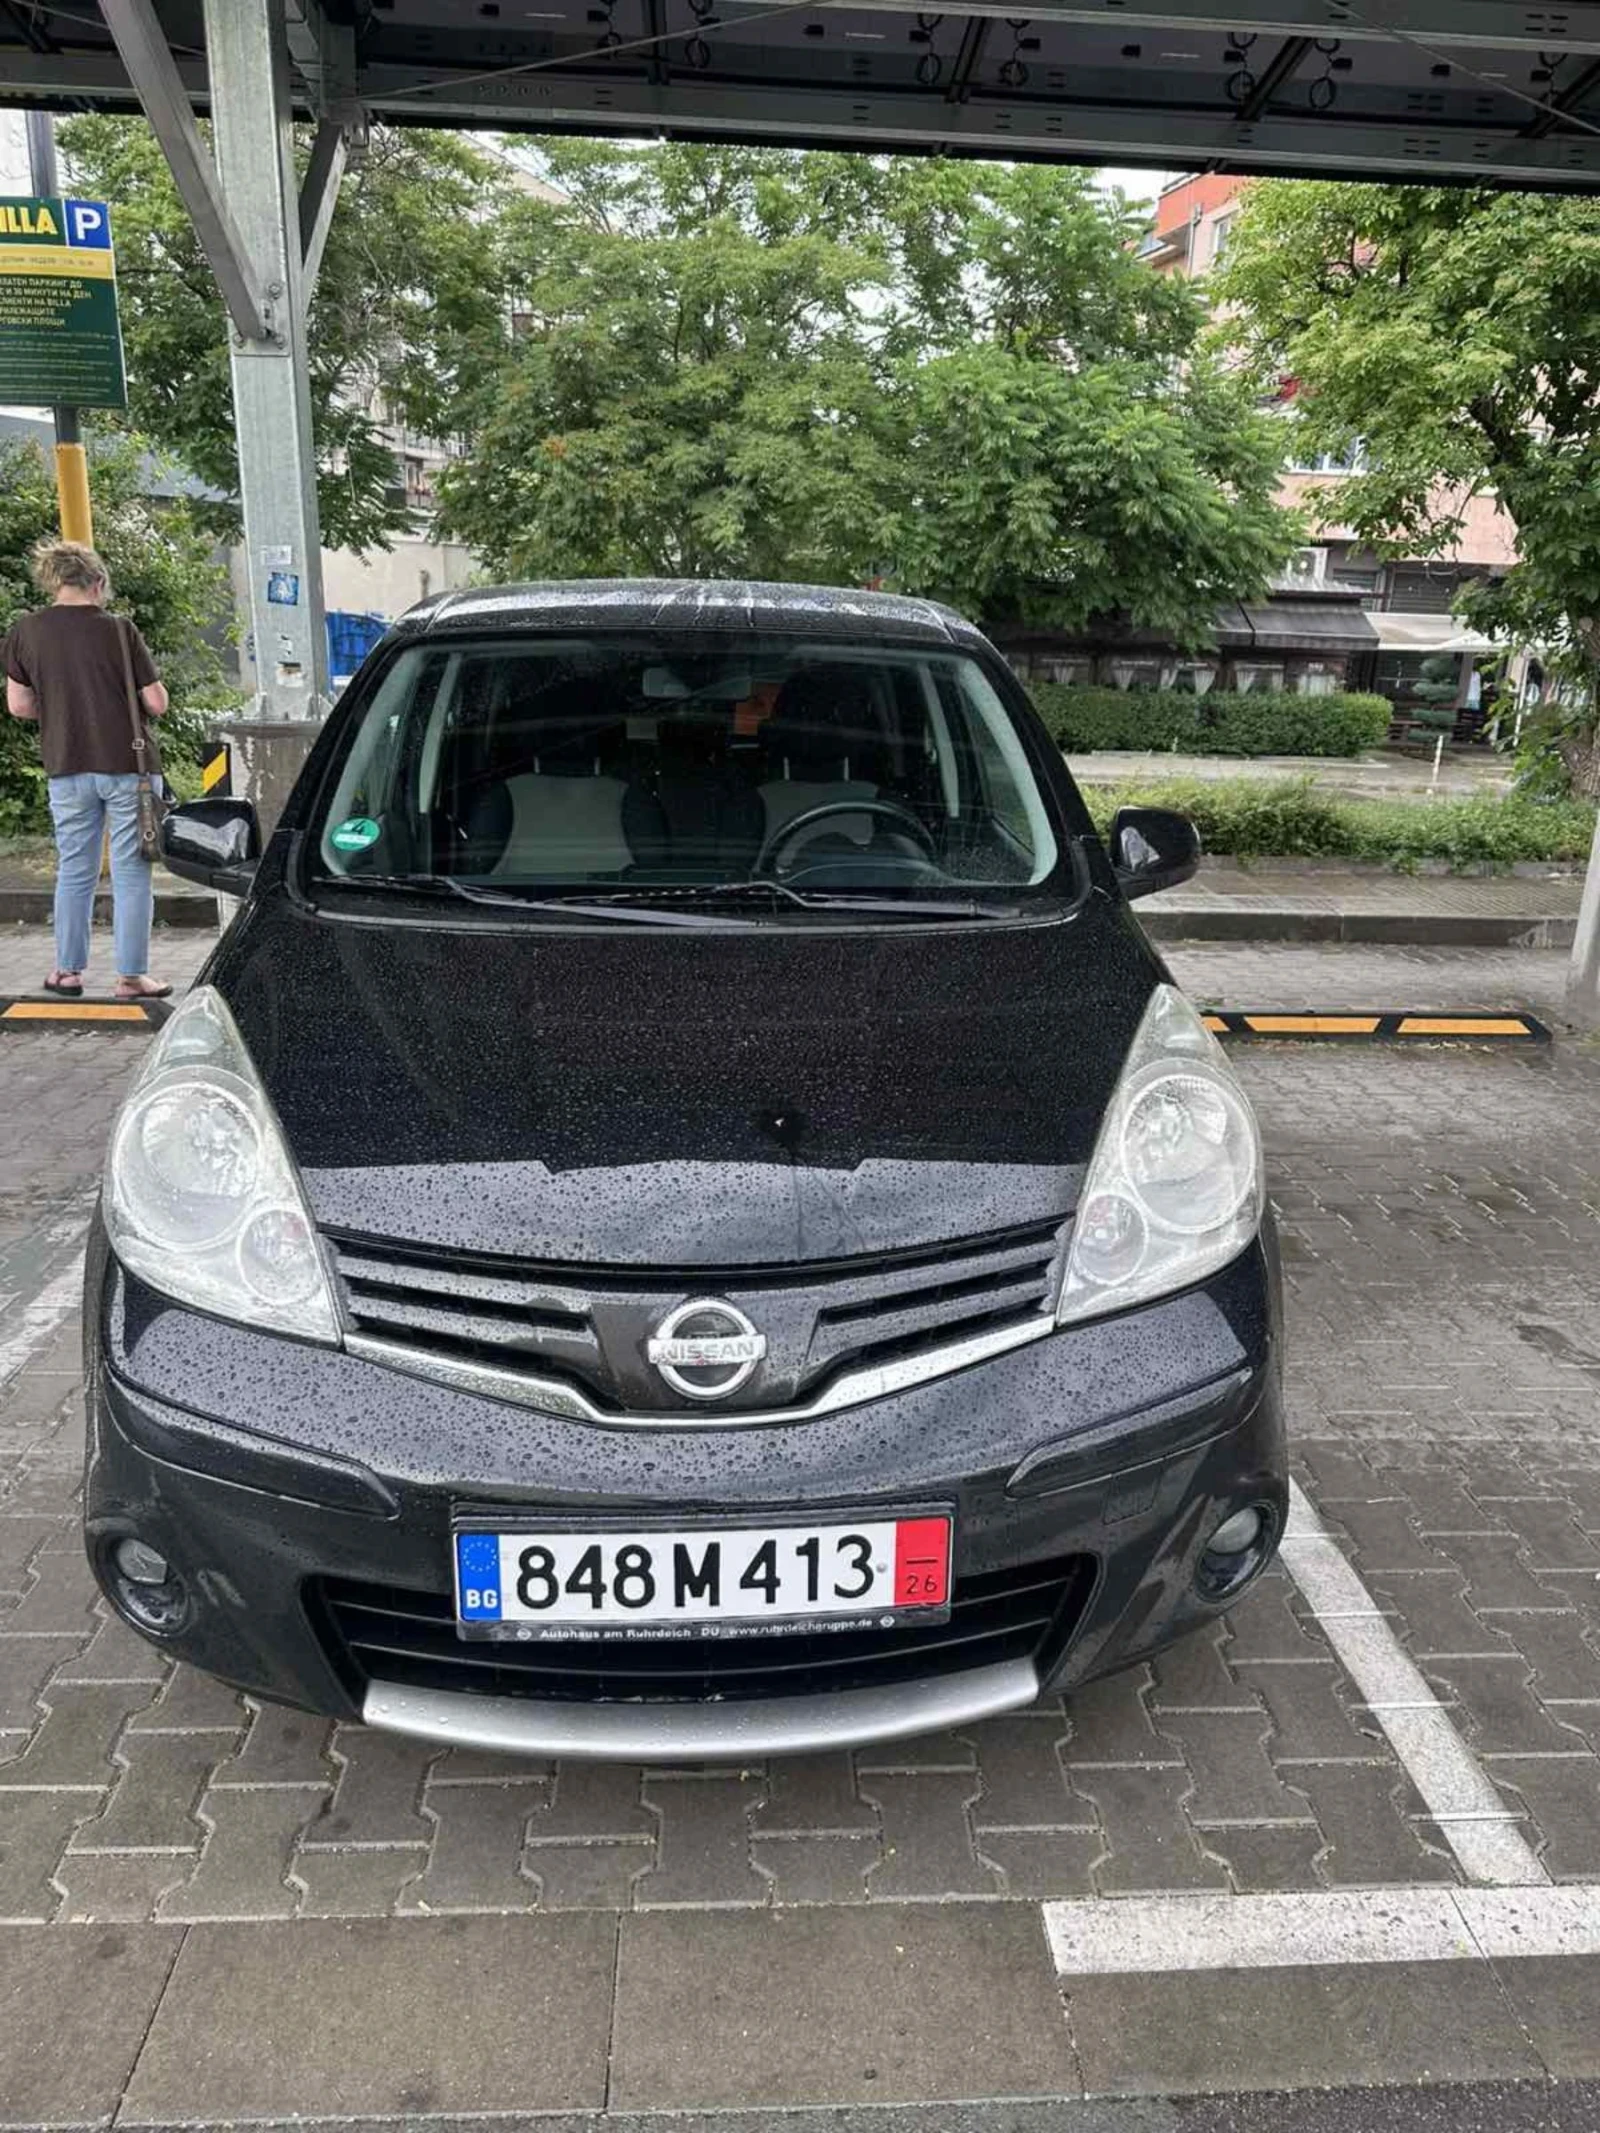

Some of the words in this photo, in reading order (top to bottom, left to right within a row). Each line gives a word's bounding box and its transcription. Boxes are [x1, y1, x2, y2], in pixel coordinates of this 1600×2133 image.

[75, 207, 101, 240] P
[28, 278, 67, 288] ПАРКИНГ
[70, 280, 82, 289] ДО
[24, 288, 58, 297] МИНУТИ
[73, 291, 92, 299] ДЕН
[662, 1341, 755, 1360] NISSAN
[466, 1589, 498, 1610] BG
[516, 1545, 656, 1610] 848
[673, 1542, 721, 1608] M
[739, 1534, 874, 1605] 413
[906, 1574, 938, 1595] 26
[540, 1629, 600, 1639] Autohaus
[604, 1631, 623, 1639] am
[701, 1627, 720, 1637] DU
